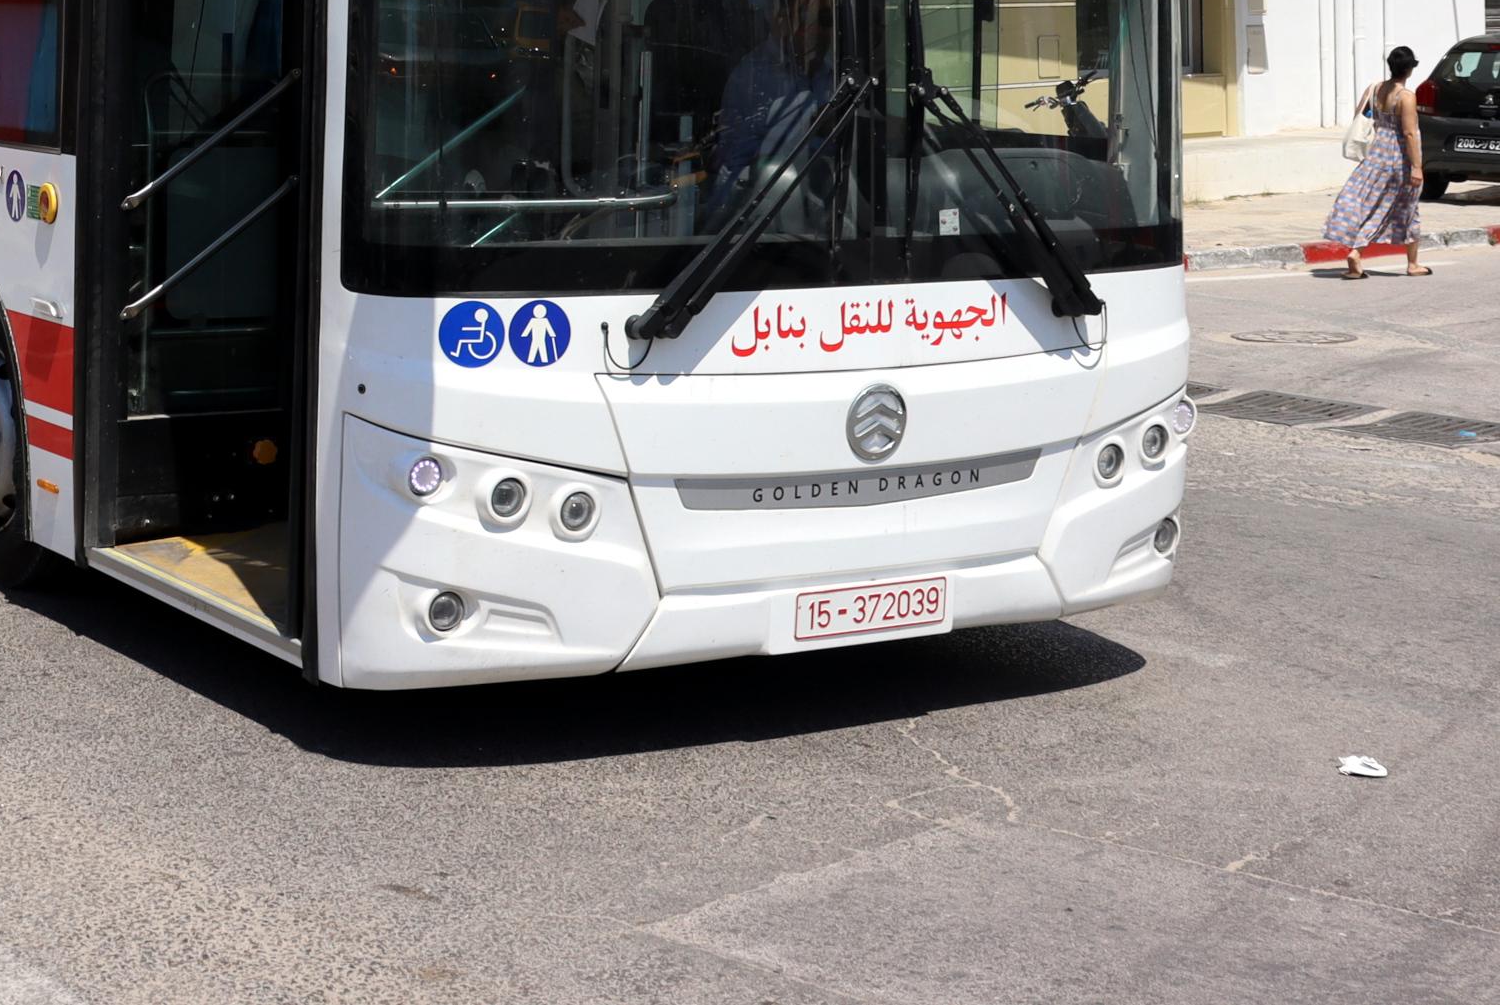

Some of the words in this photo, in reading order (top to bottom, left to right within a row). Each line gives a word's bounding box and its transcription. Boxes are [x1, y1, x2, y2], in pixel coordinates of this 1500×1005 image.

[1457, 138, 1475, 149] 200
[731, 302, 807, 358] بنابل
[819, 298, 895, 353] للنقل
[904, 292, 1007, 346] الجهوية
[752, 479, 860, 503] GOLDEN
[878, 467, 981, 493] DRAGON
[807, 586, 940, 630] 15-372039
